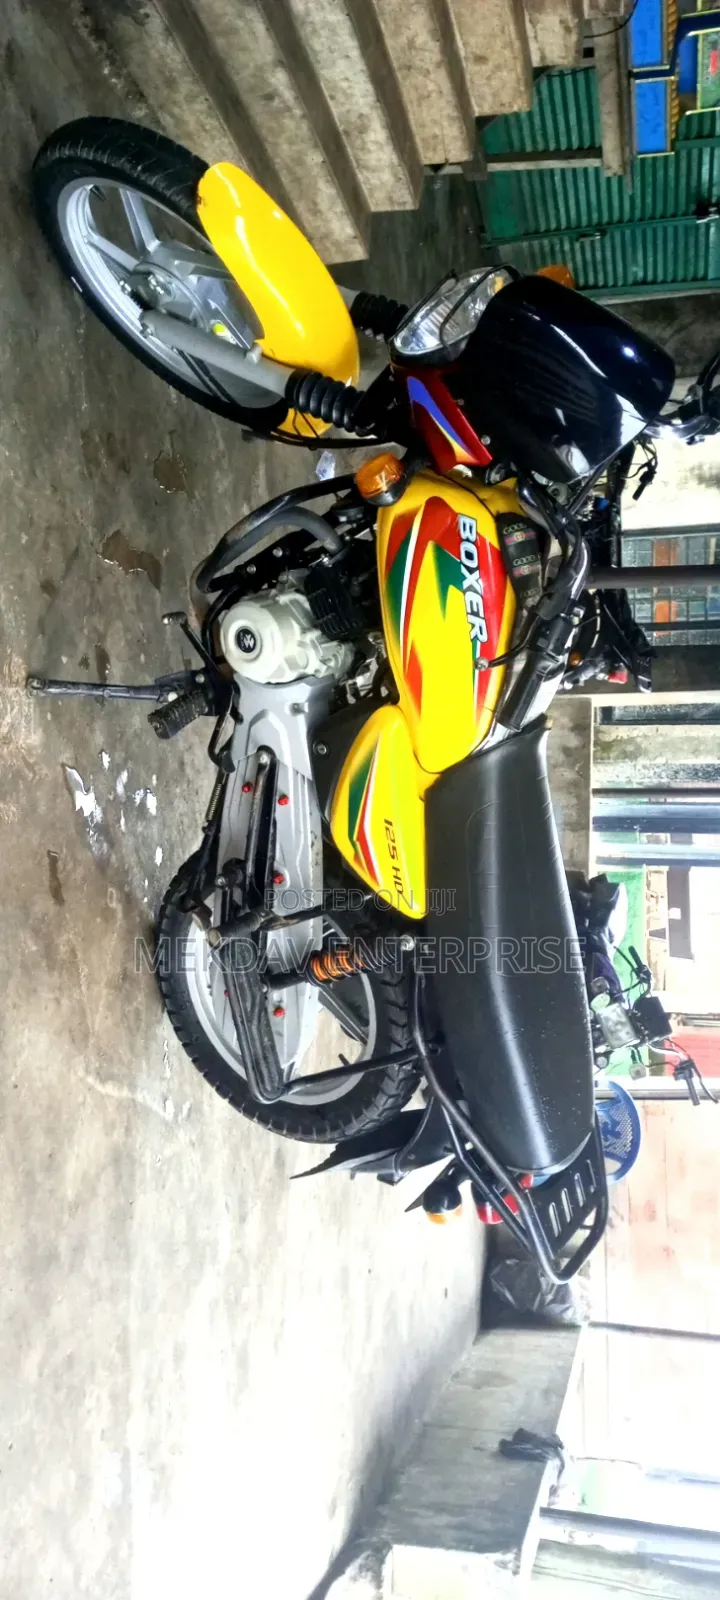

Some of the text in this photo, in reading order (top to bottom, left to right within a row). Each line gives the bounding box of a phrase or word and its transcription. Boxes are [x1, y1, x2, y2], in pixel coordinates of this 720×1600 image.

[458, 513, 488, 643] BOXER
[384, 818, 404, 895] 125 HD
